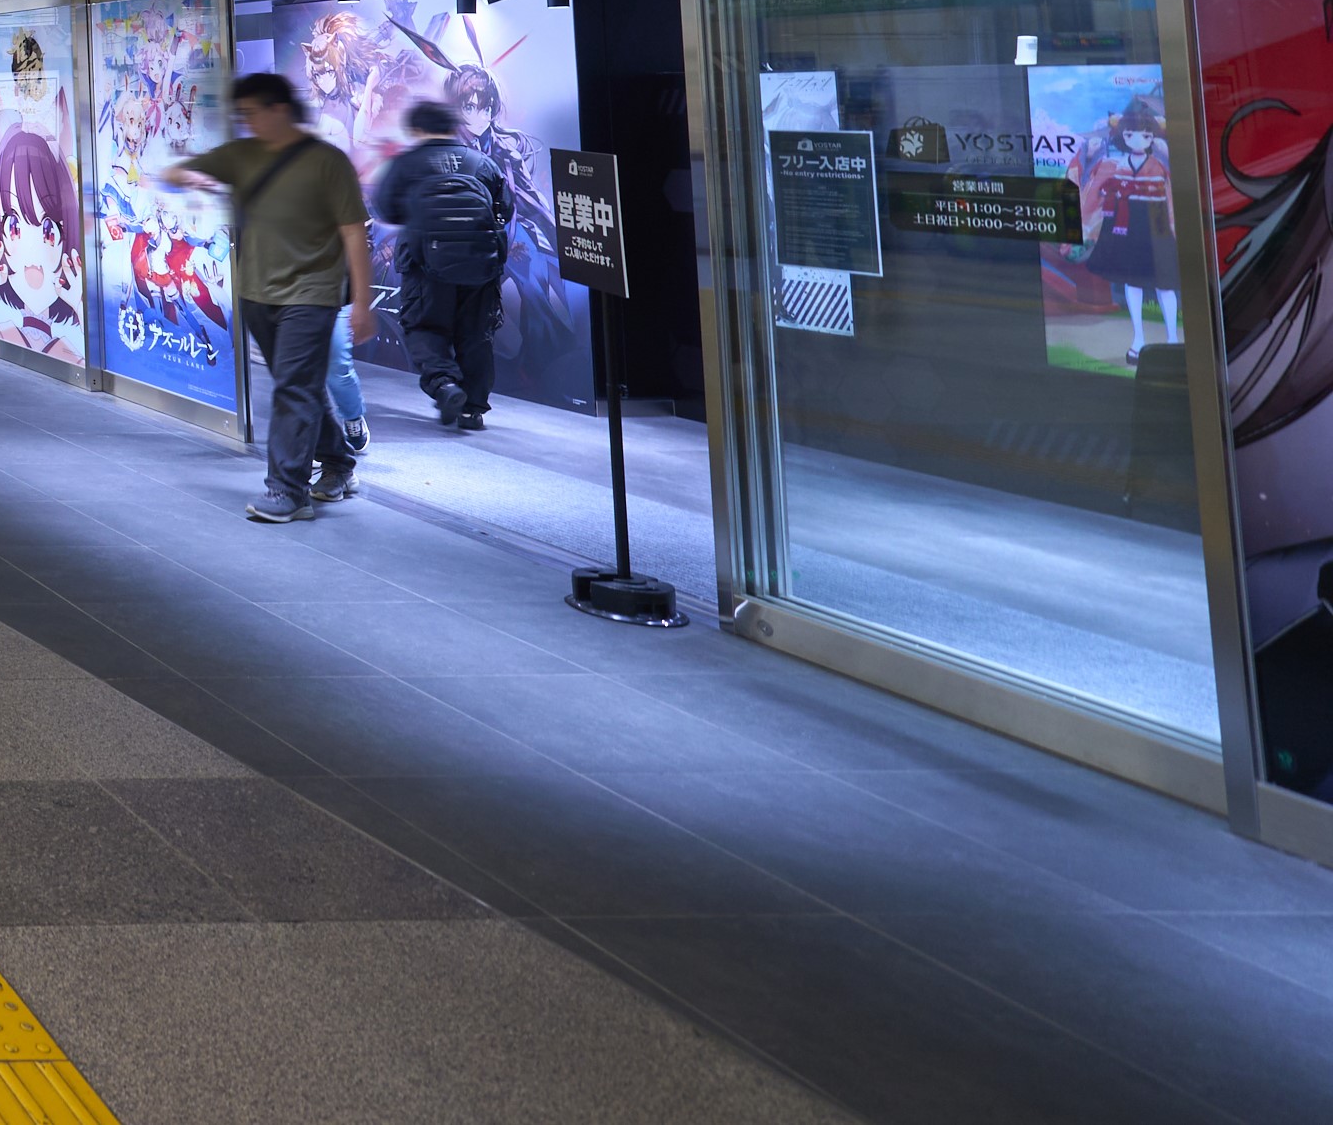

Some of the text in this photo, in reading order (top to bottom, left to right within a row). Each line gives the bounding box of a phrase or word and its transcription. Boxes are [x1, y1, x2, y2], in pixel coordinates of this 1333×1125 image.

[955, 133, 1077, 154] YOSTAR
[779, 156, 866, 172] フリー入店中
[1029, 157, 1066, 168] SHOP
[795, 171, 815, 179] entry
[951, 180, 1004, 195] 営業時間
[557, 190, 614, 237] 営業中
[571, 236, 603, 253] ご予約なしで
[148, 320, 219, 360] アズールレーン
[163, 354, 205, 371] AZUR LANE
